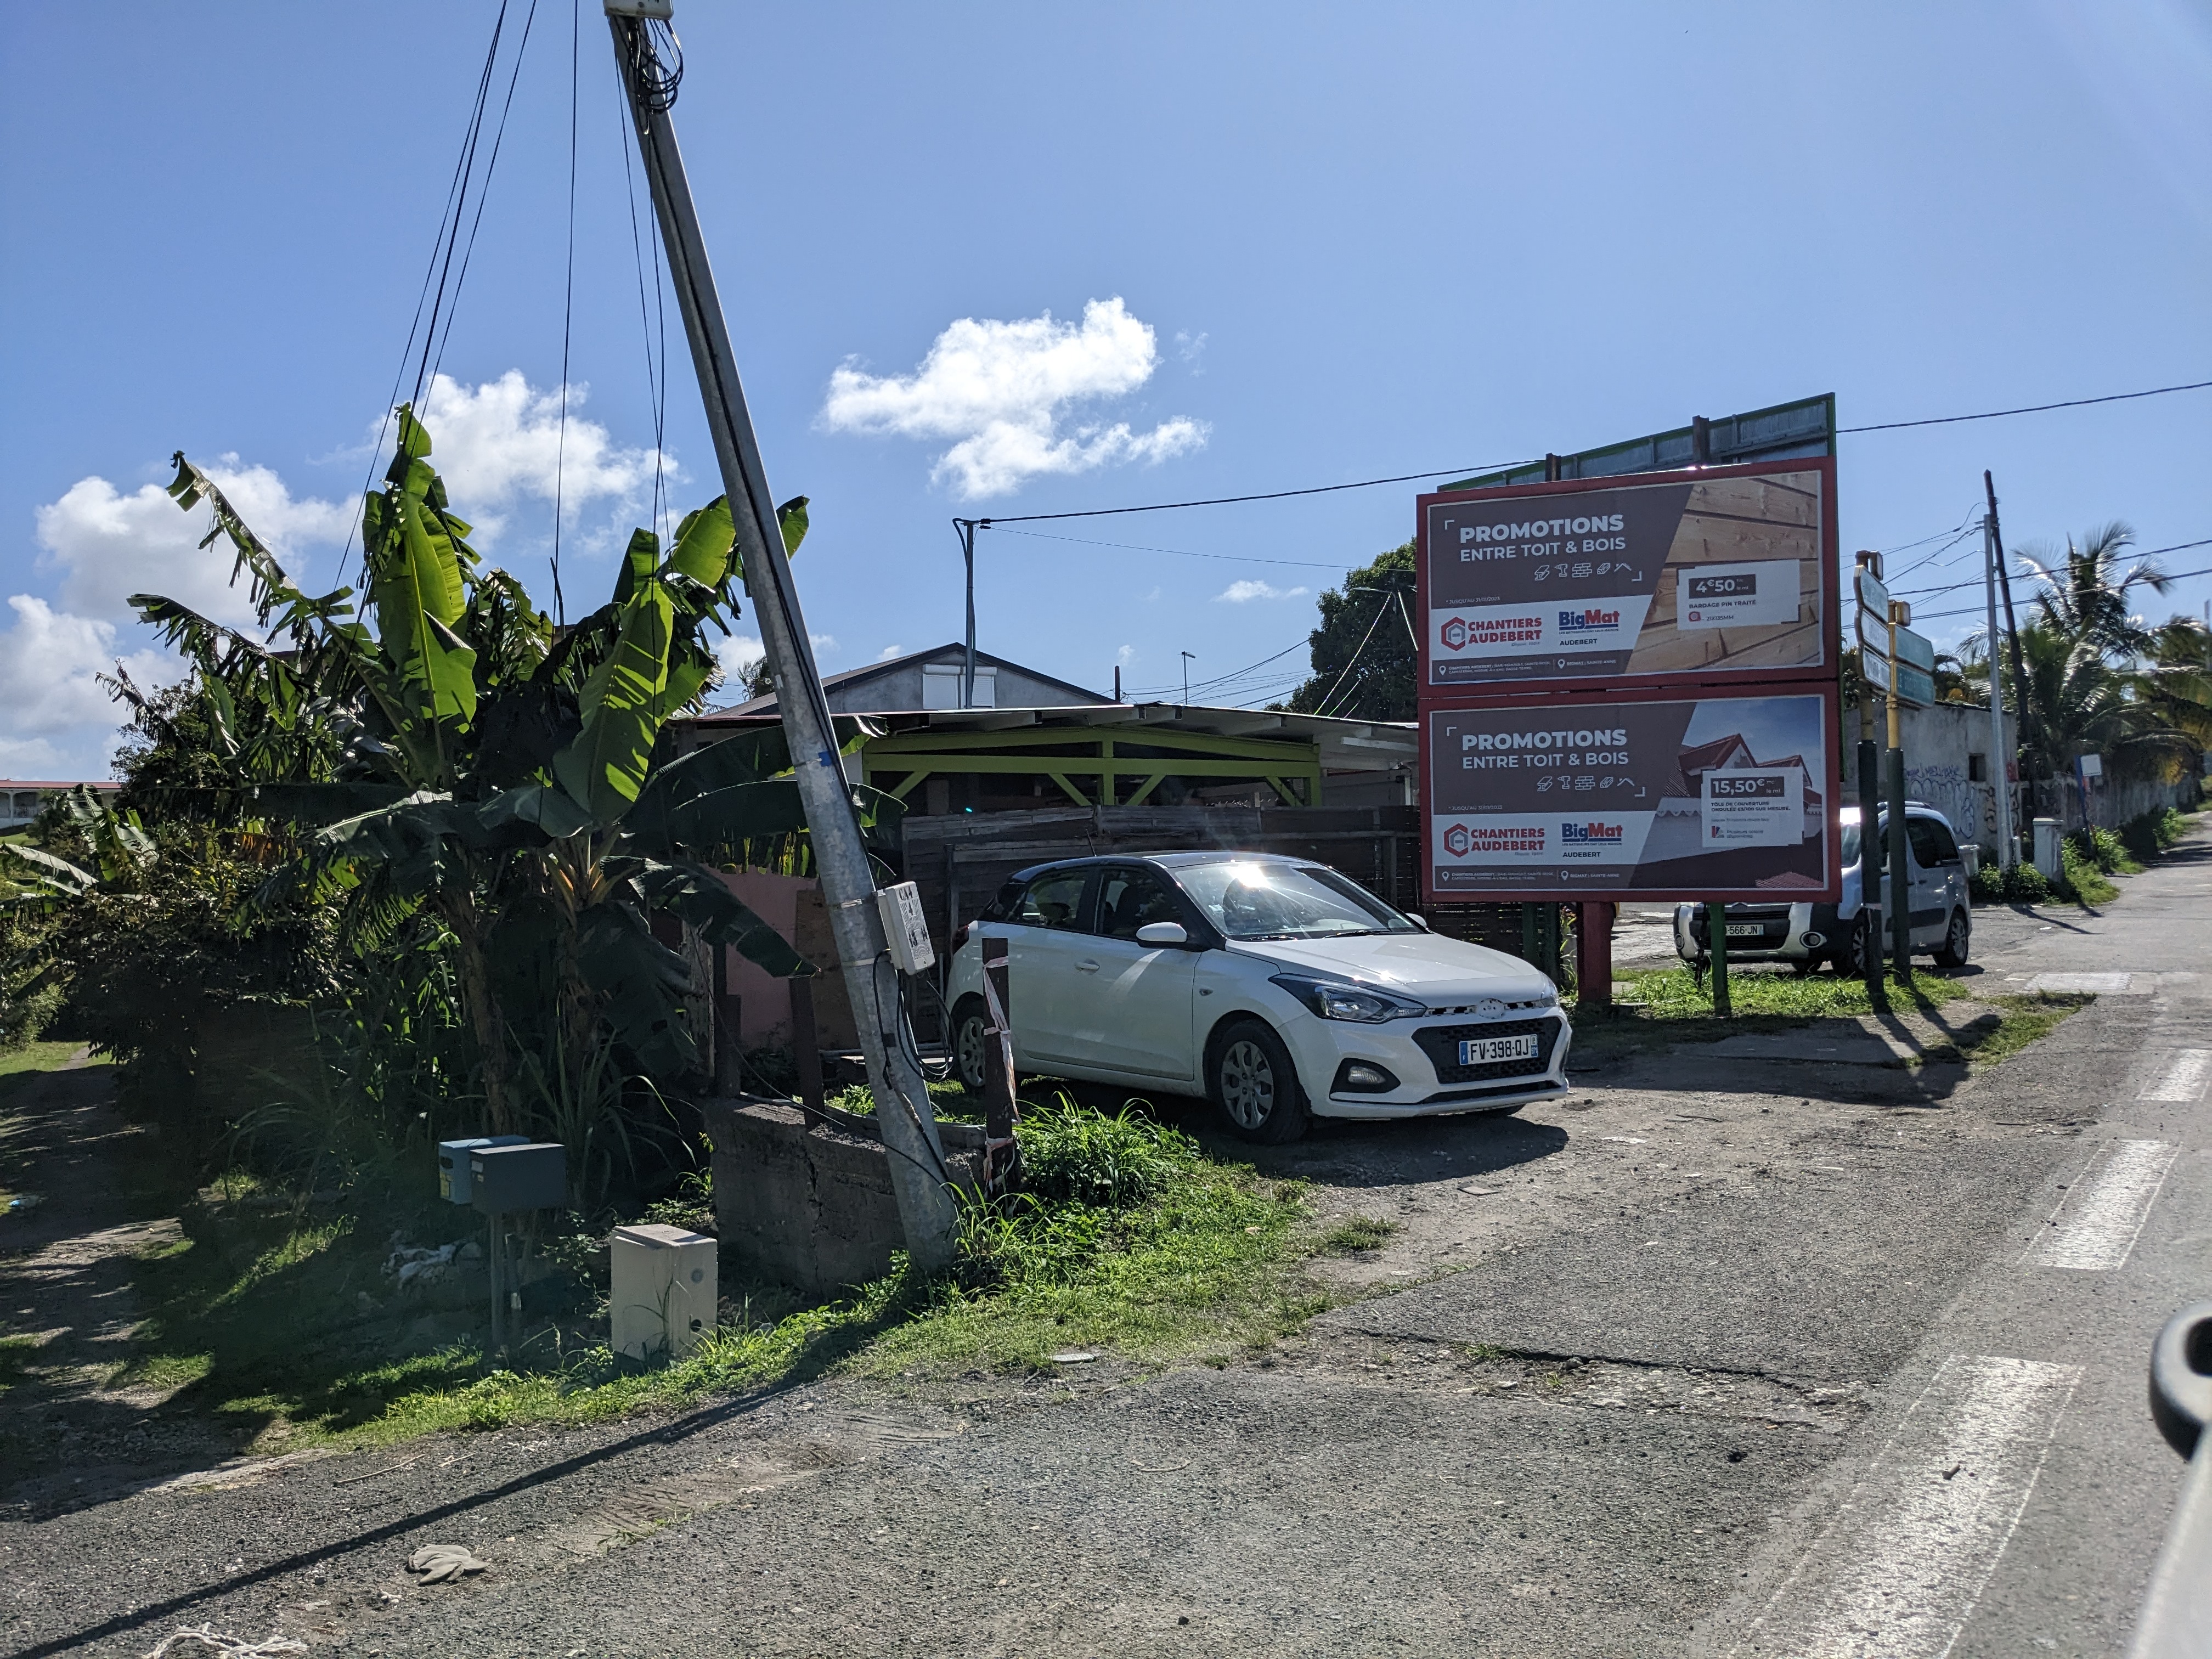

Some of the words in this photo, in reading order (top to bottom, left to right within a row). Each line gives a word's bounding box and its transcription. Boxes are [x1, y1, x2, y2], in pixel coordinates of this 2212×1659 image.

[1460, 514, 1624, 544] PROMOTIONS
[1460, 546, 1516, 562] ENTRE
[1521, 542, 1560, 557] TOIT
[1565, 541, 1577, 554] &
[1583, 537, 1626, 552] BOIS
[1468, 617, 1542, 631] CHANTIERS
[1559, 610, 1620, 629] BigMat
[1468, 629, 1542, 644] AUDEBERT
[1462, 729, 1627, 751] PROMOTIONS
[1463, 755, 1519, 769] ENTRE
[1523, 754, 1564, 767] TOIT
[1568, 753, 1581, 766] &
[1585, 752, 1628, 765] BOIS
[1471, 828, 1545, 839] CHANTIERS
[1561, 823, 1622, 842] BigMat
[1471, 840, 1545, 851] AUDEBERT
[1725, 926, 1758, 934] -566-JN
[1470, 1038, 1528, 1061] FV-398-QJ
